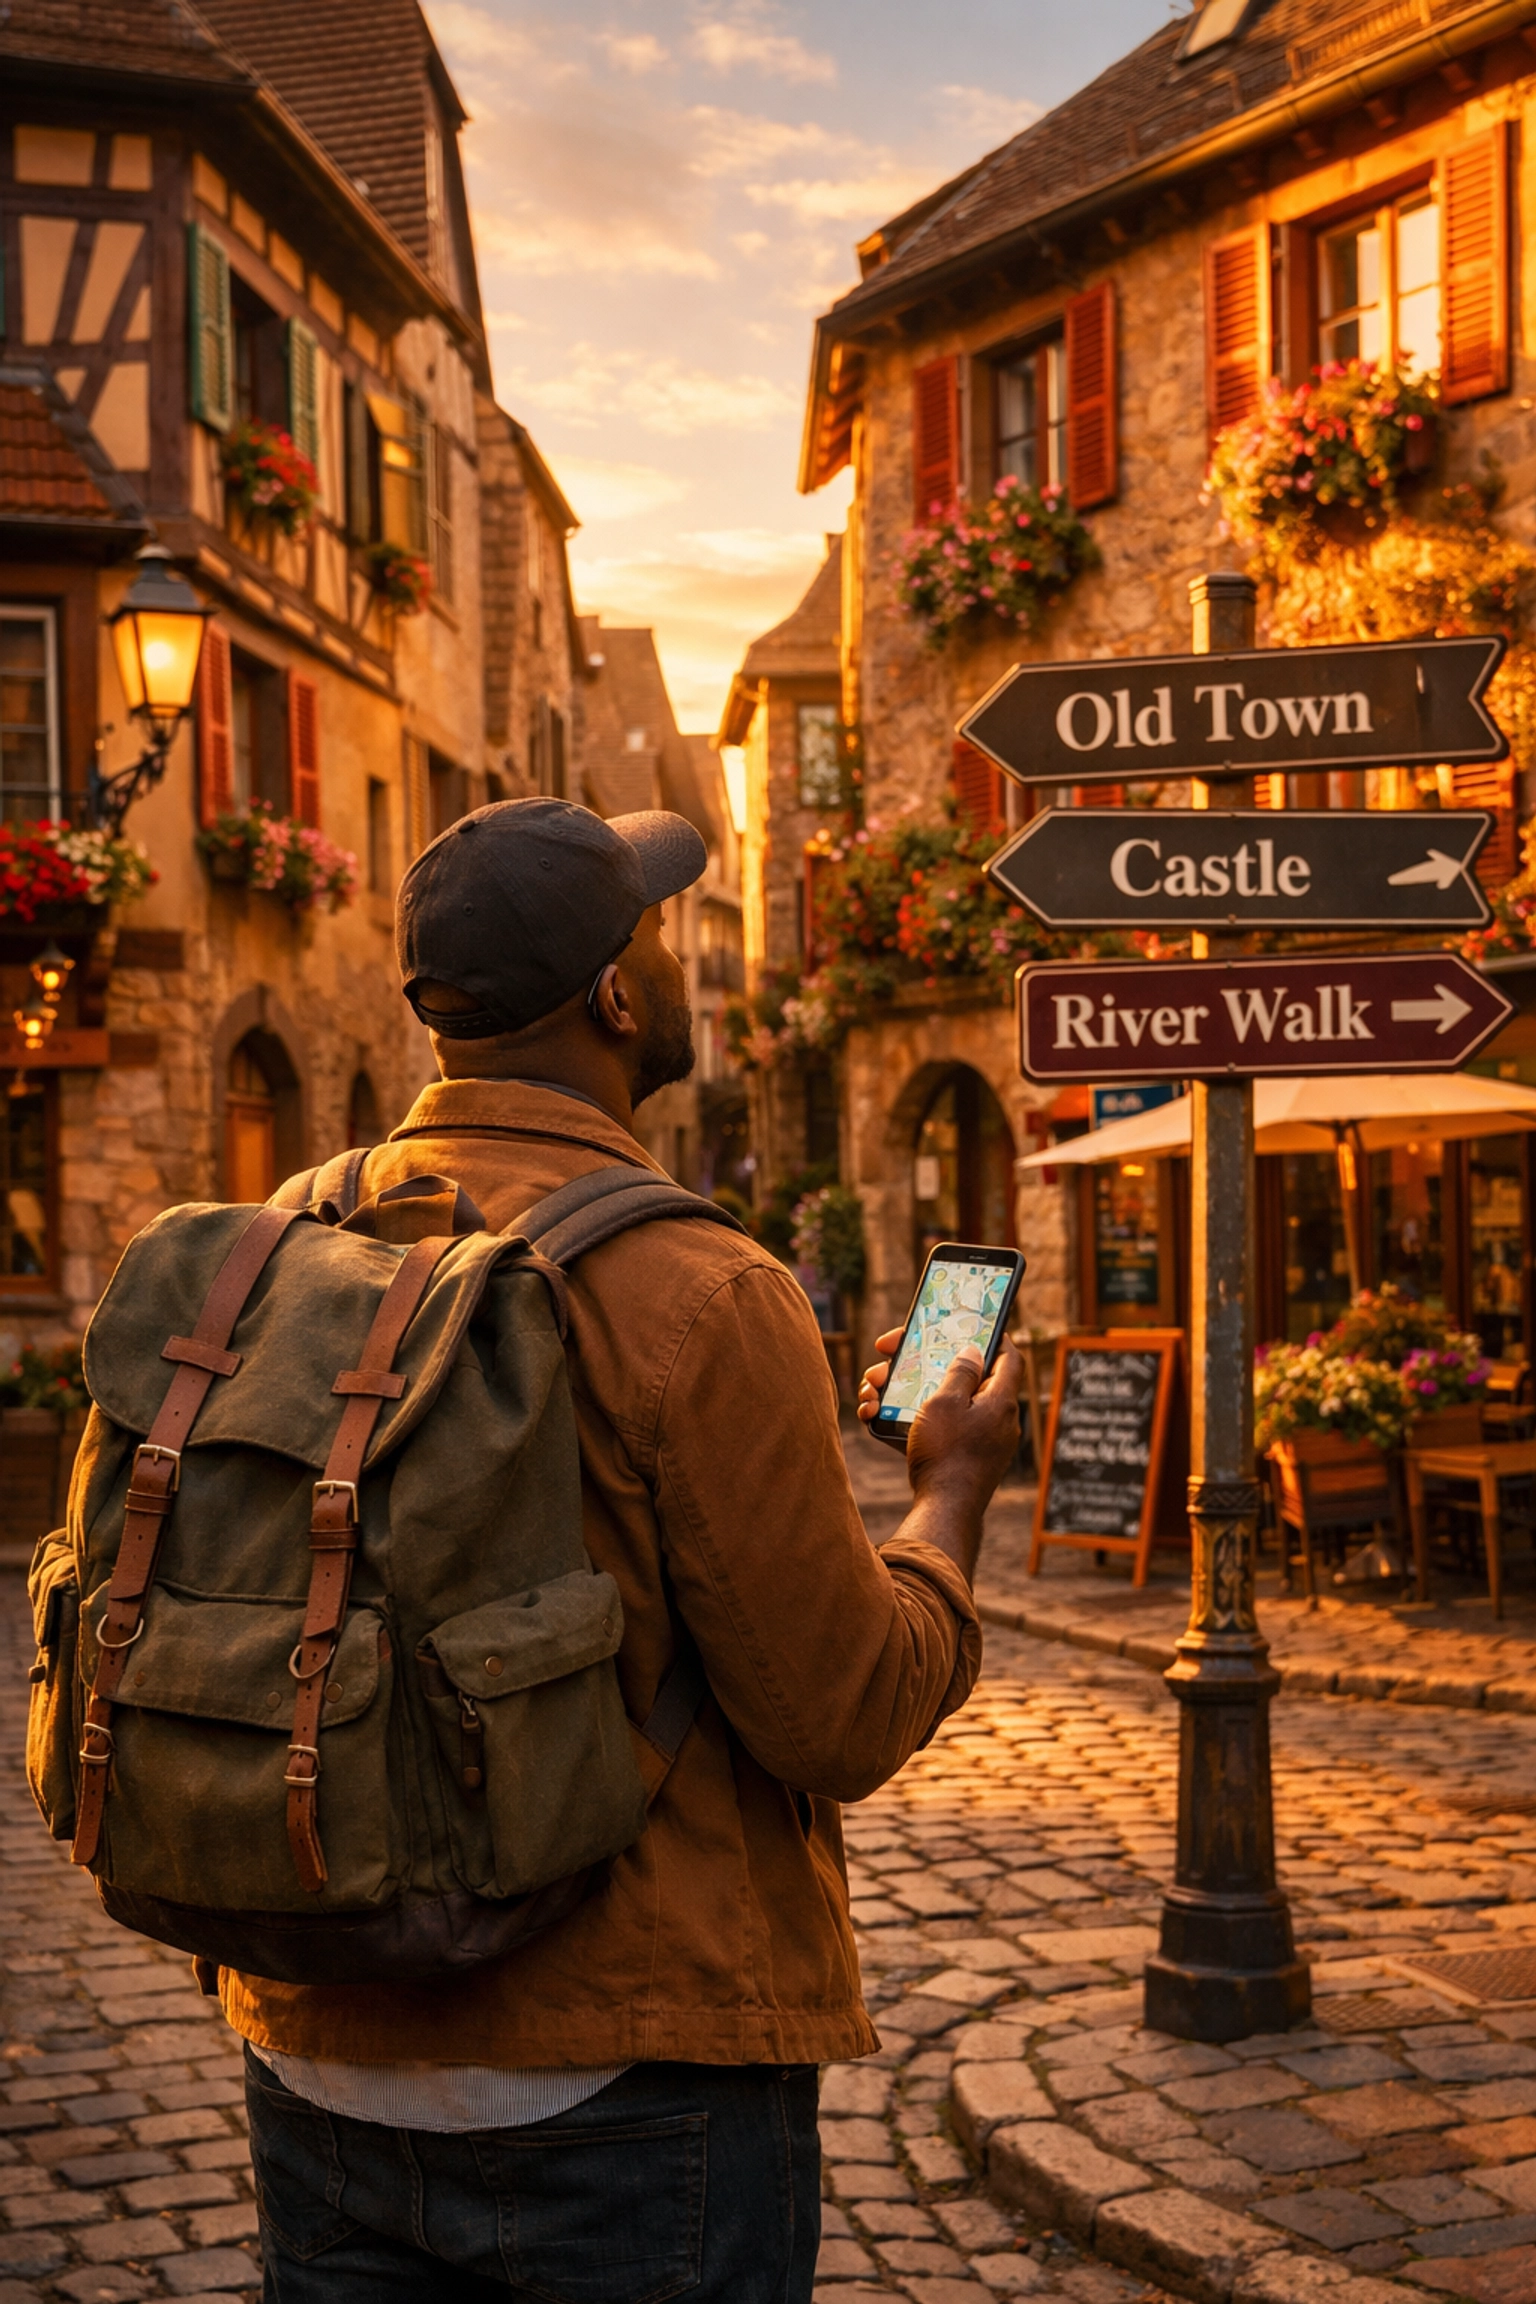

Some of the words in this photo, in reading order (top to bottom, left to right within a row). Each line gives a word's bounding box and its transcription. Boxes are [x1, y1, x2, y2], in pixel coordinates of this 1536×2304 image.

[1056, 686, 1175, 751] Old
[1195, 683, 1373, 742] Town
[1110, 838, 1311, 898] Castle
[1051, 994, 1209, 1049] River
[1221, 984, 1375, 1043] Walk
